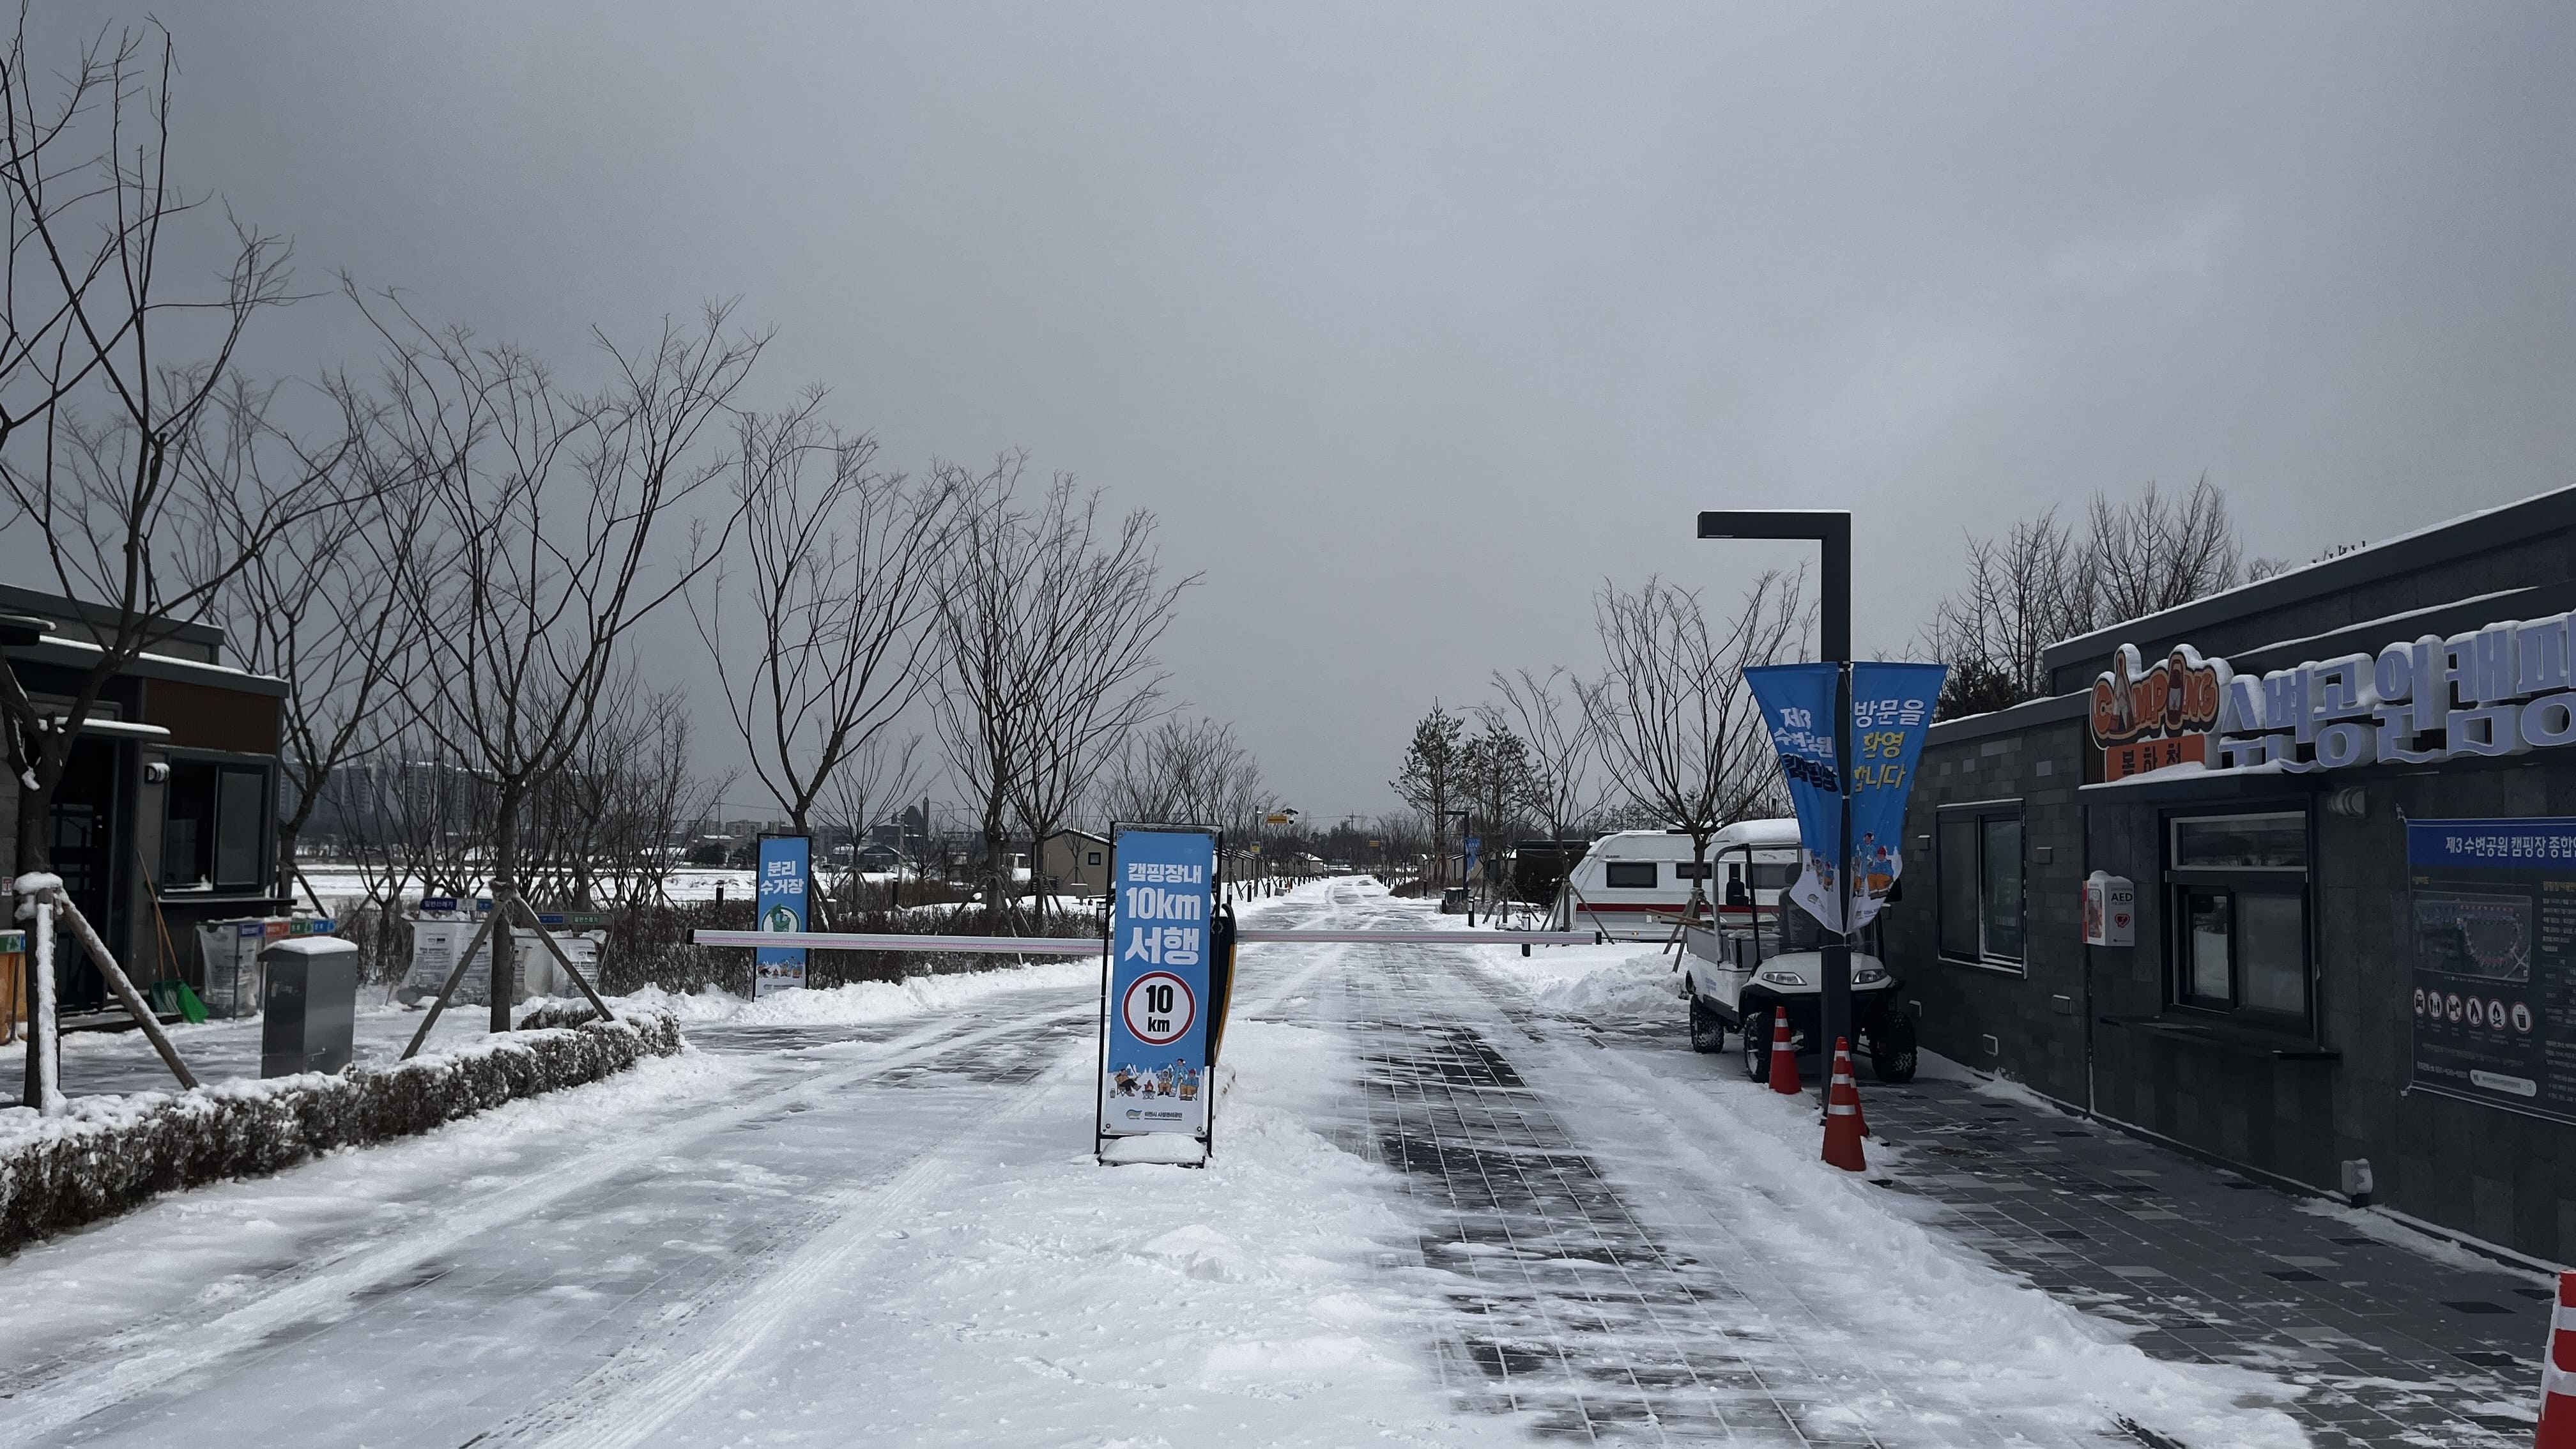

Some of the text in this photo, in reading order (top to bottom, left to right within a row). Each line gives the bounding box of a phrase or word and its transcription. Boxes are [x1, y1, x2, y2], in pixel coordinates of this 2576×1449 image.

[1854, 699, 1925, 728] 방문을
[1862, 731, 1905, 758] 환영
[2446, 836, 2462, 854] 제3
[2464, 836, 2508, 857] 수변공원
[2511, 836, 2546, 858] 캠핑장
[767, 861, 796, 877] 분리
[1128, 863, 1202, 884] 캠핑장내
[760, 878, 805, 896] 수거장
[2111, 893, 2133, 901] AED
[1126, 887, 1201, 921] 10km
[1124, 926, 1199, 965] 서행
[1146, 985, 1174, 1014] 10
[1147, 1016, 1170, 1033] km
